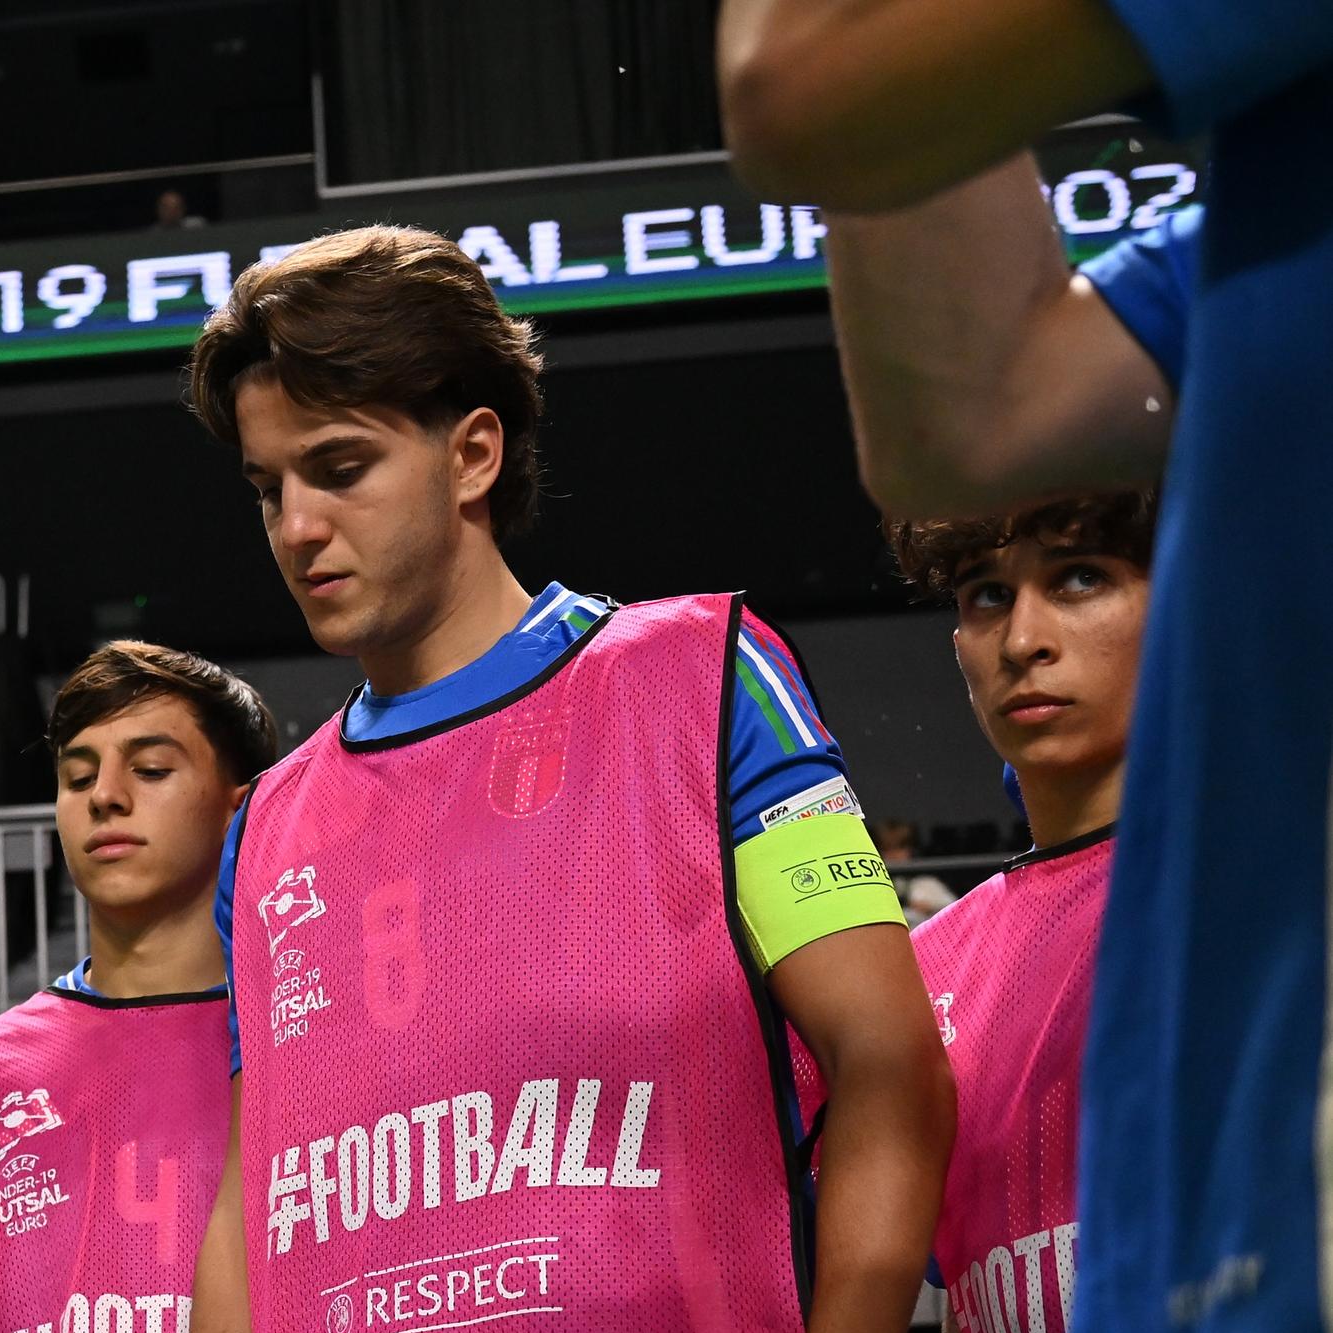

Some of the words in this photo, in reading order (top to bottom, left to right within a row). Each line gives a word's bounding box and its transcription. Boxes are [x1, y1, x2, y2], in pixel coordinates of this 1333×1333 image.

[764, 805, 789, 823] UEFA
[270, 986, 332, 1031] UTSAL
[274, 1019, 308, 1048] EURO
[2, 1157, 37, 1179] UEFA
[267, 1078, 661, 1261] #FOOTBALL
[6, 1212, 48, 1237] EURO
[366, 1254, 559, 1328] RESPECT
